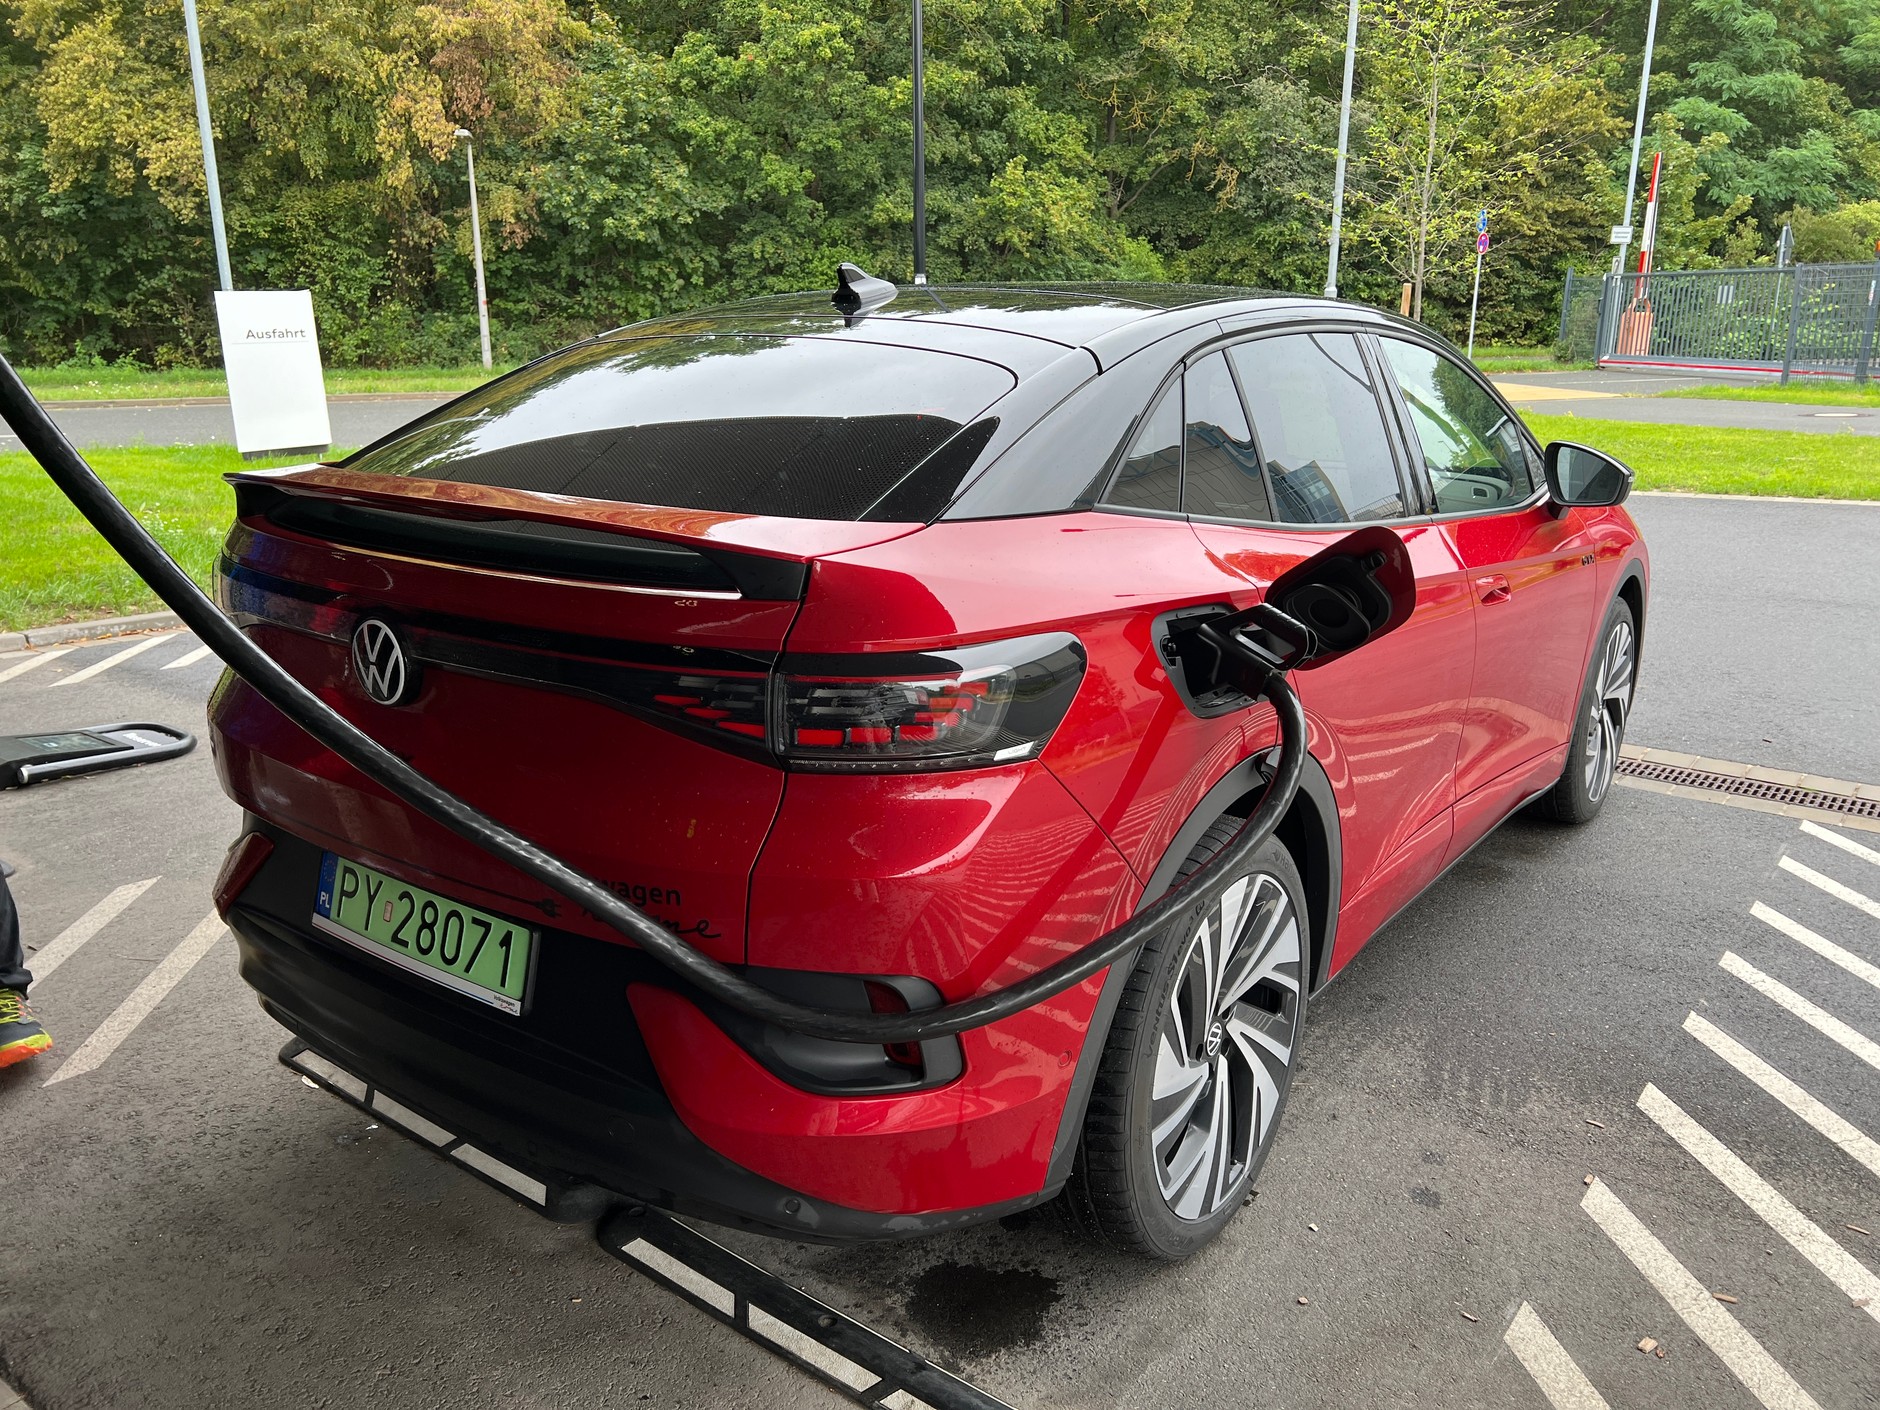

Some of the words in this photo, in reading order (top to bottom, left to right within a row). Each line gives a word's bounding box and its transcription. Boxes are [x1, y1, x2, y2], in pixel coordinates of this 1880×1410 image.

[246, 328, 306, 339] Ausfahrt
[320, 891, 330, 909] PL
[336, 865, 384, 932] PY
[390, 890, 514, 989] 28071
